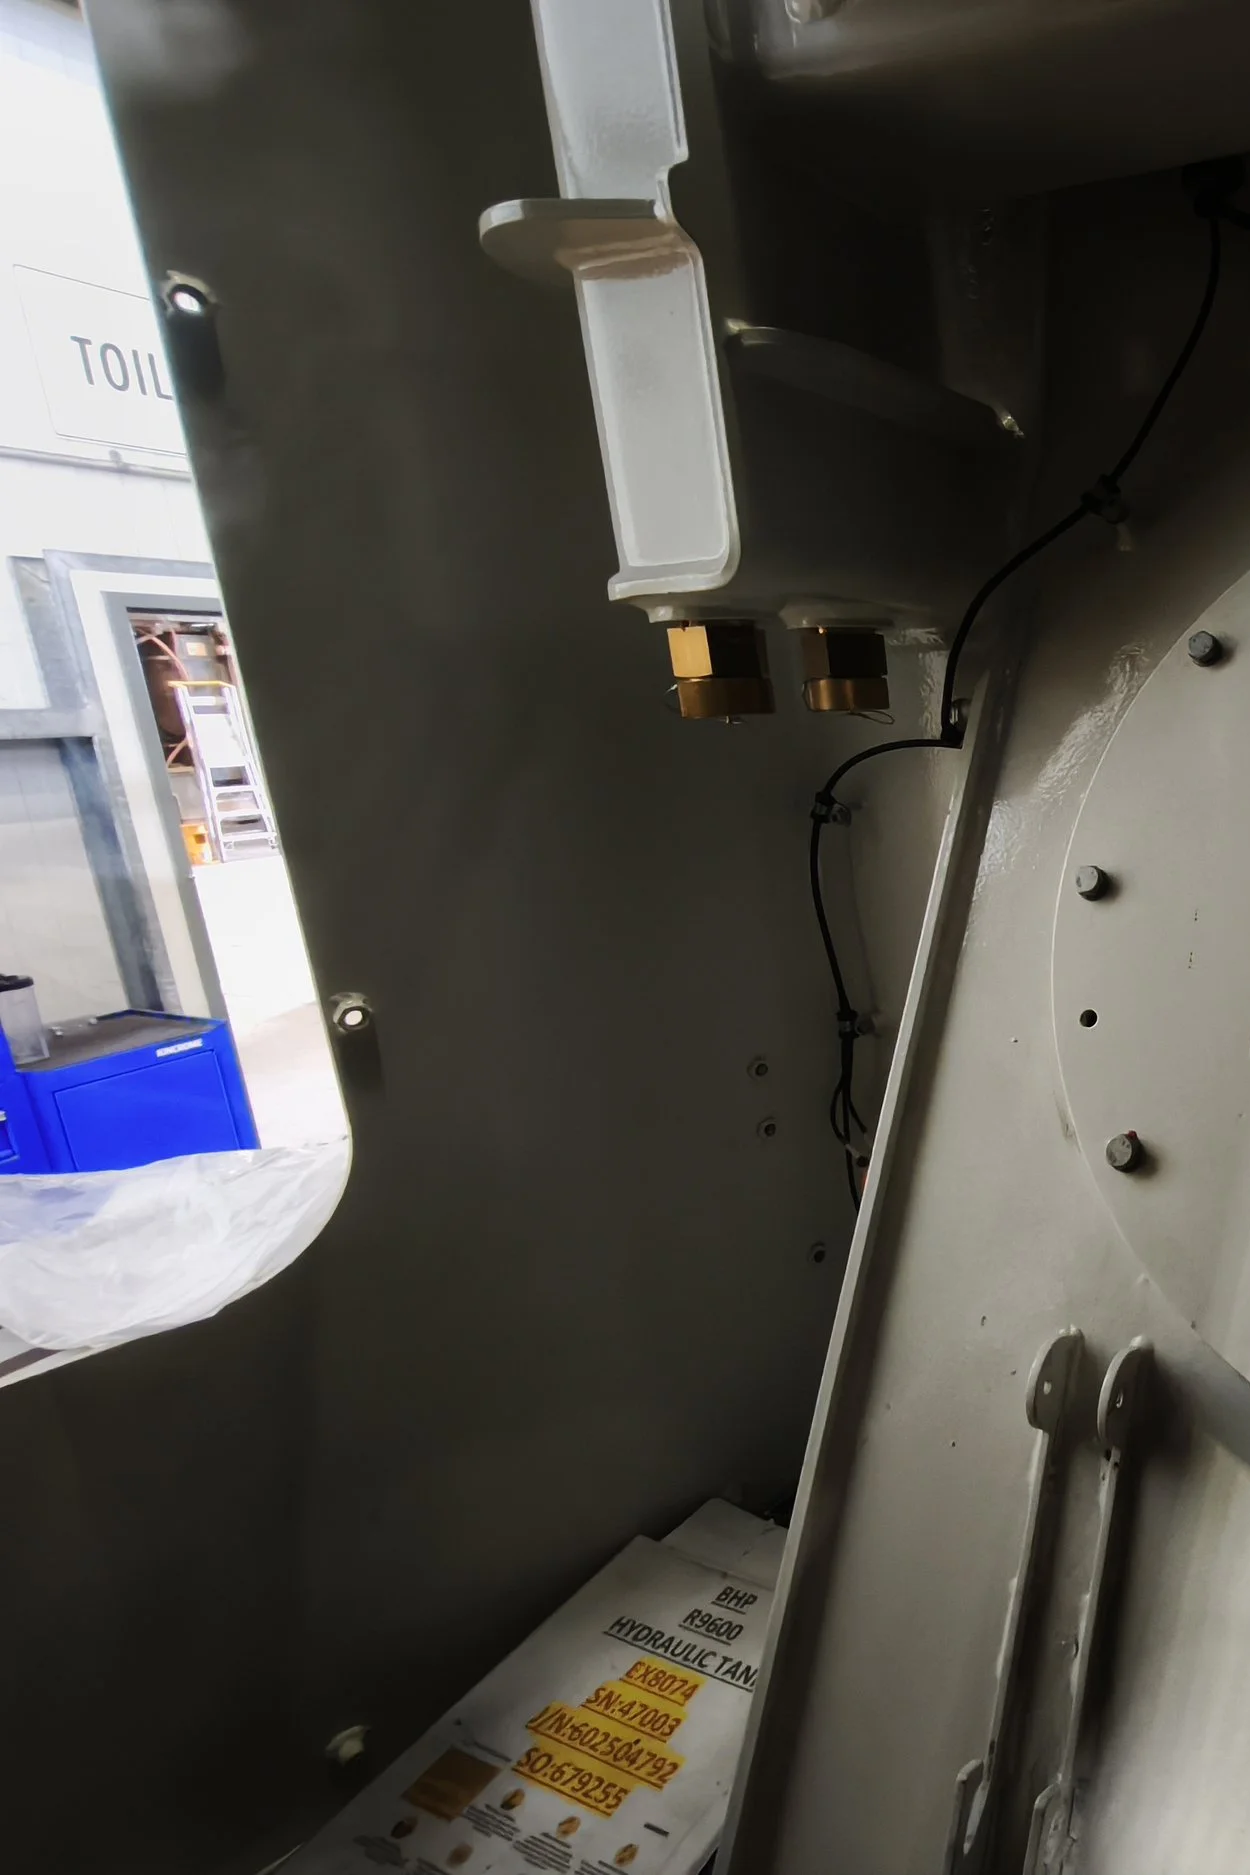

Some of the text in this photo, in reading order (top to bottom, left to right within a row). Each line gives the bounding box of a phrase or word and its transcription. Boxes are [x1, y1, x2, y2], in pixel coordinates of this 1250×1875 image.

[714, 1586, 758, 1609] BHP
[682, 1608, 744, 1641] R9600
[608, 1615, 759, 1688] HYDRAULIC TAN
[624, 1660, 700, 1702] EX8074
[584, 1687, 682, 1738] SN:47003
[516, 1747, 632, 1810] SO:679255
